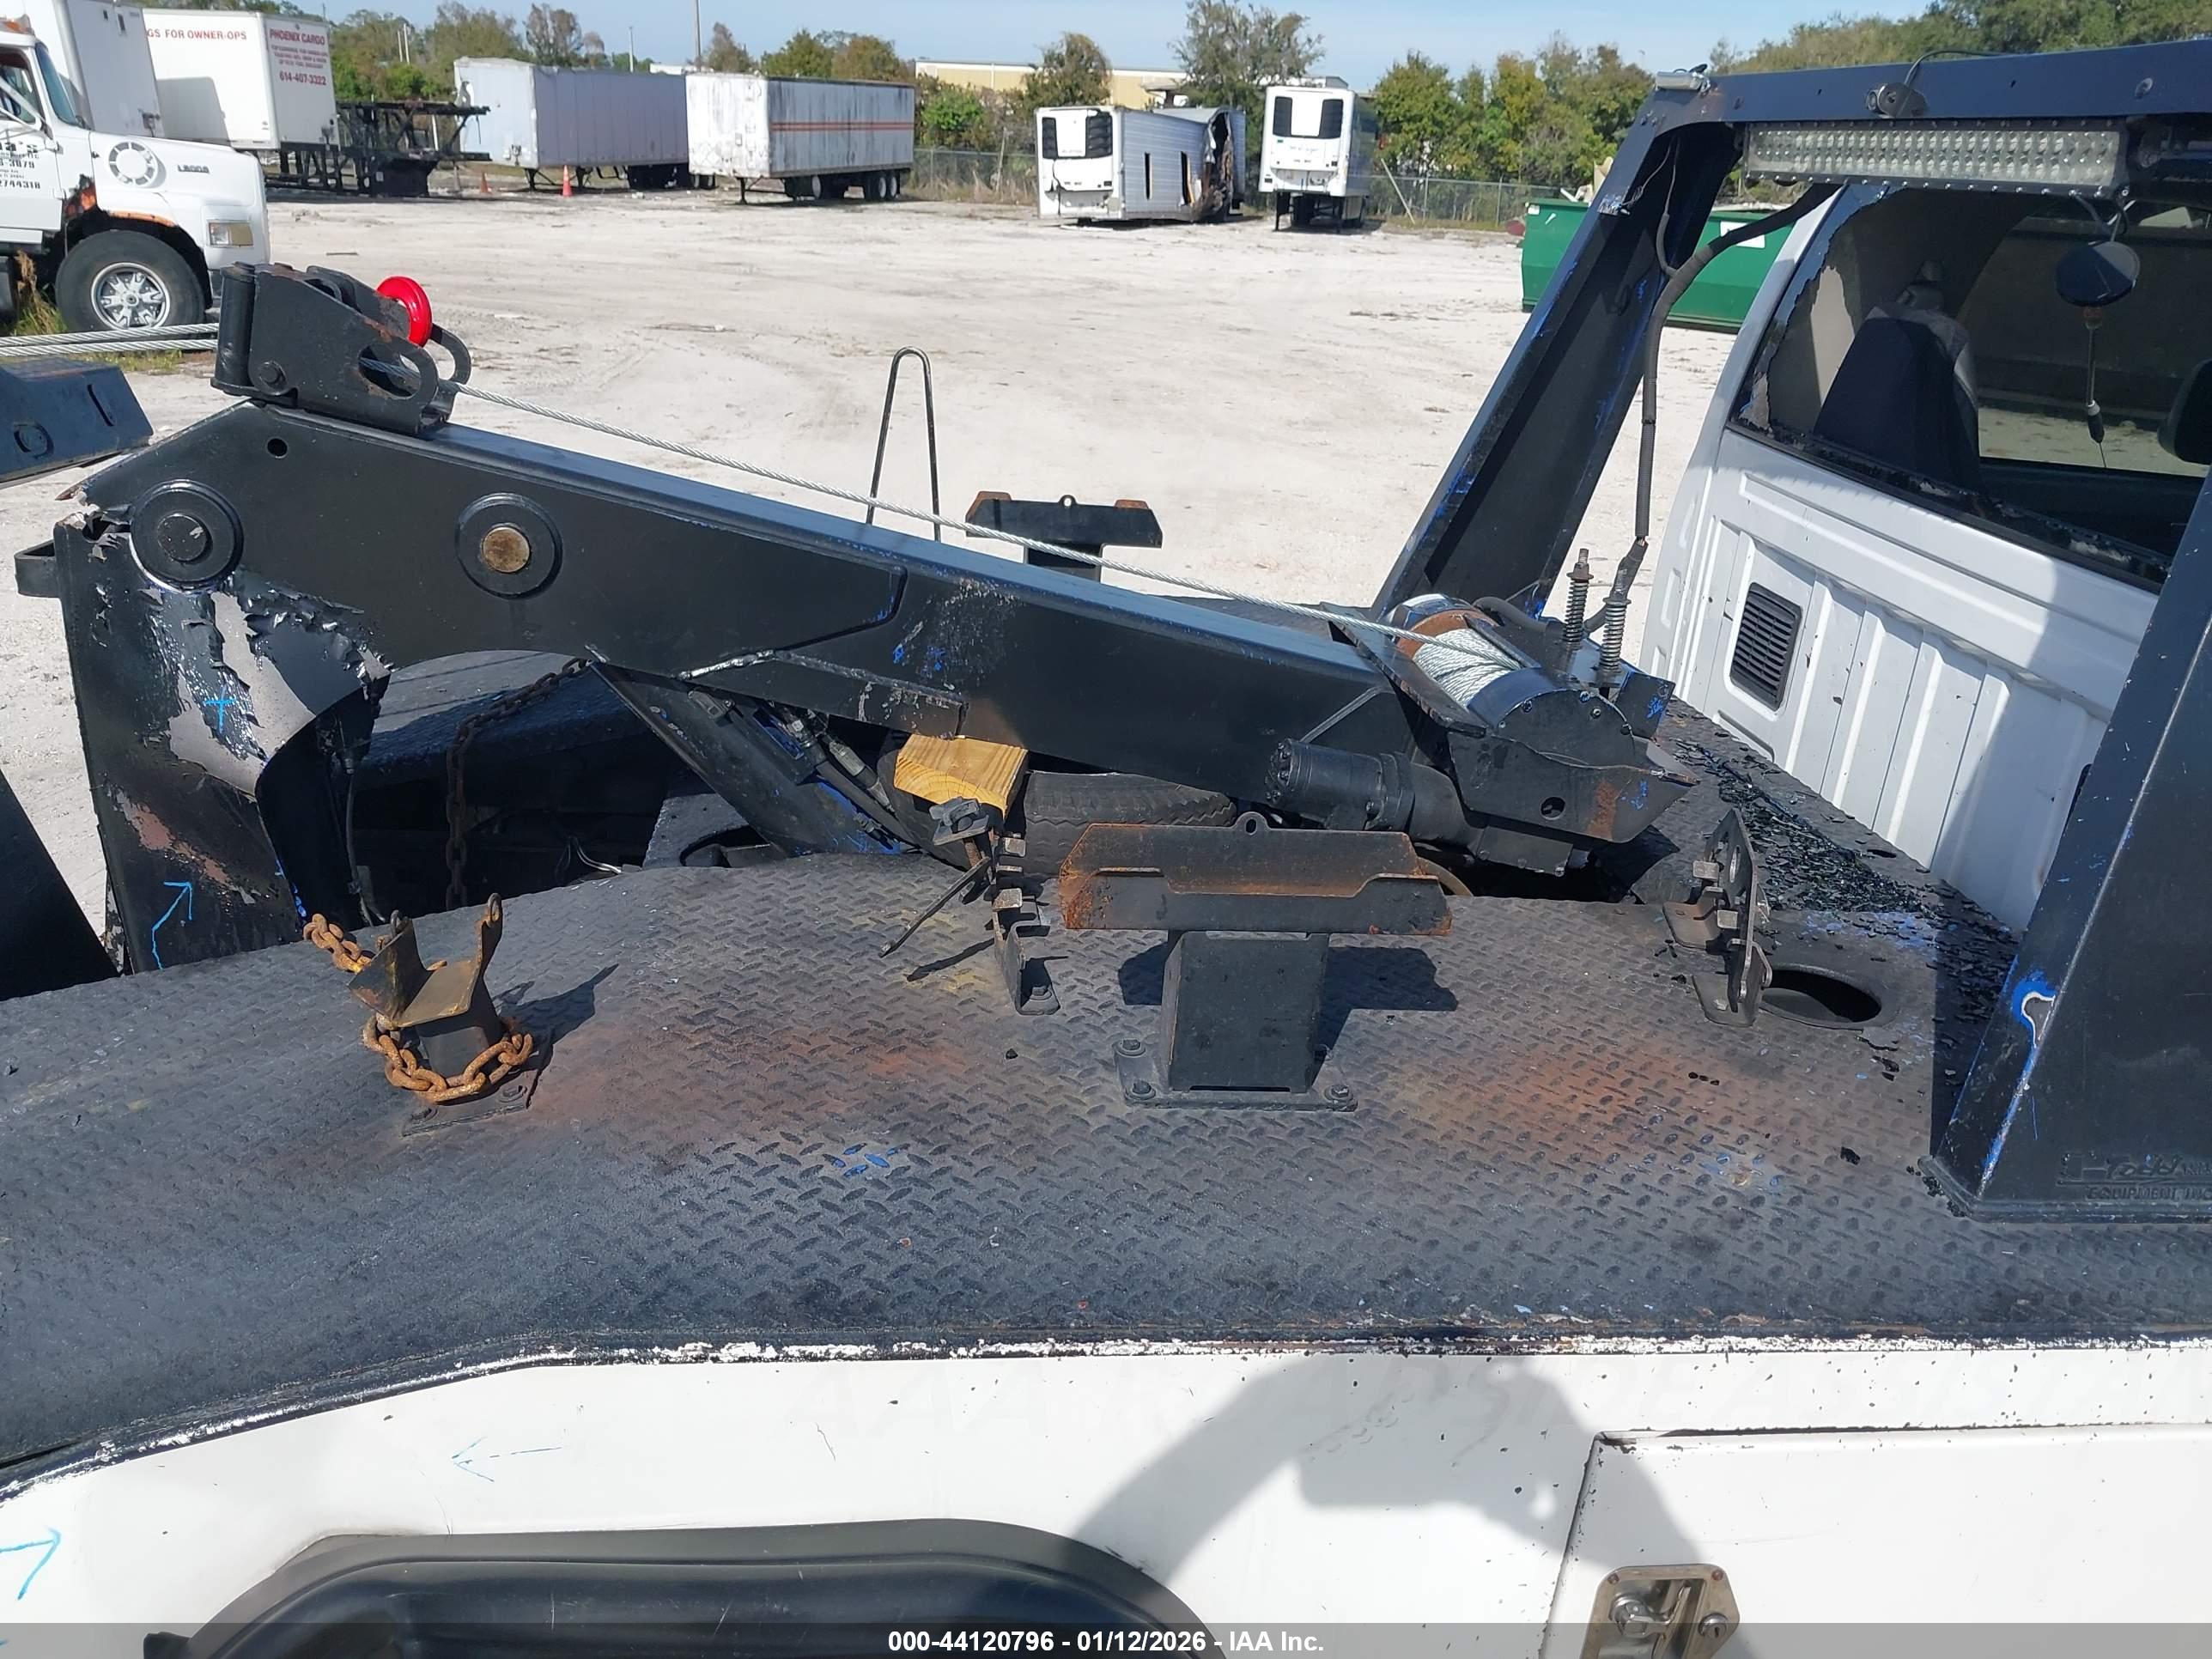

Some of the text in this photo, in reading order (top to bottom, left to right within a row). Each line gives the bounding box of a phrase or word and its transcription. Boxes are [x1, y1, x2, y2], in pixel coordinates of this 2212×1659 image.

[165, 29, 185, 39] FOR
[187, 30, 247, 40] OWNER-OPS
[270, 28, 325, 46] PHOENIX CARGO
[279, 70, 327, 85] 614-407-3322
